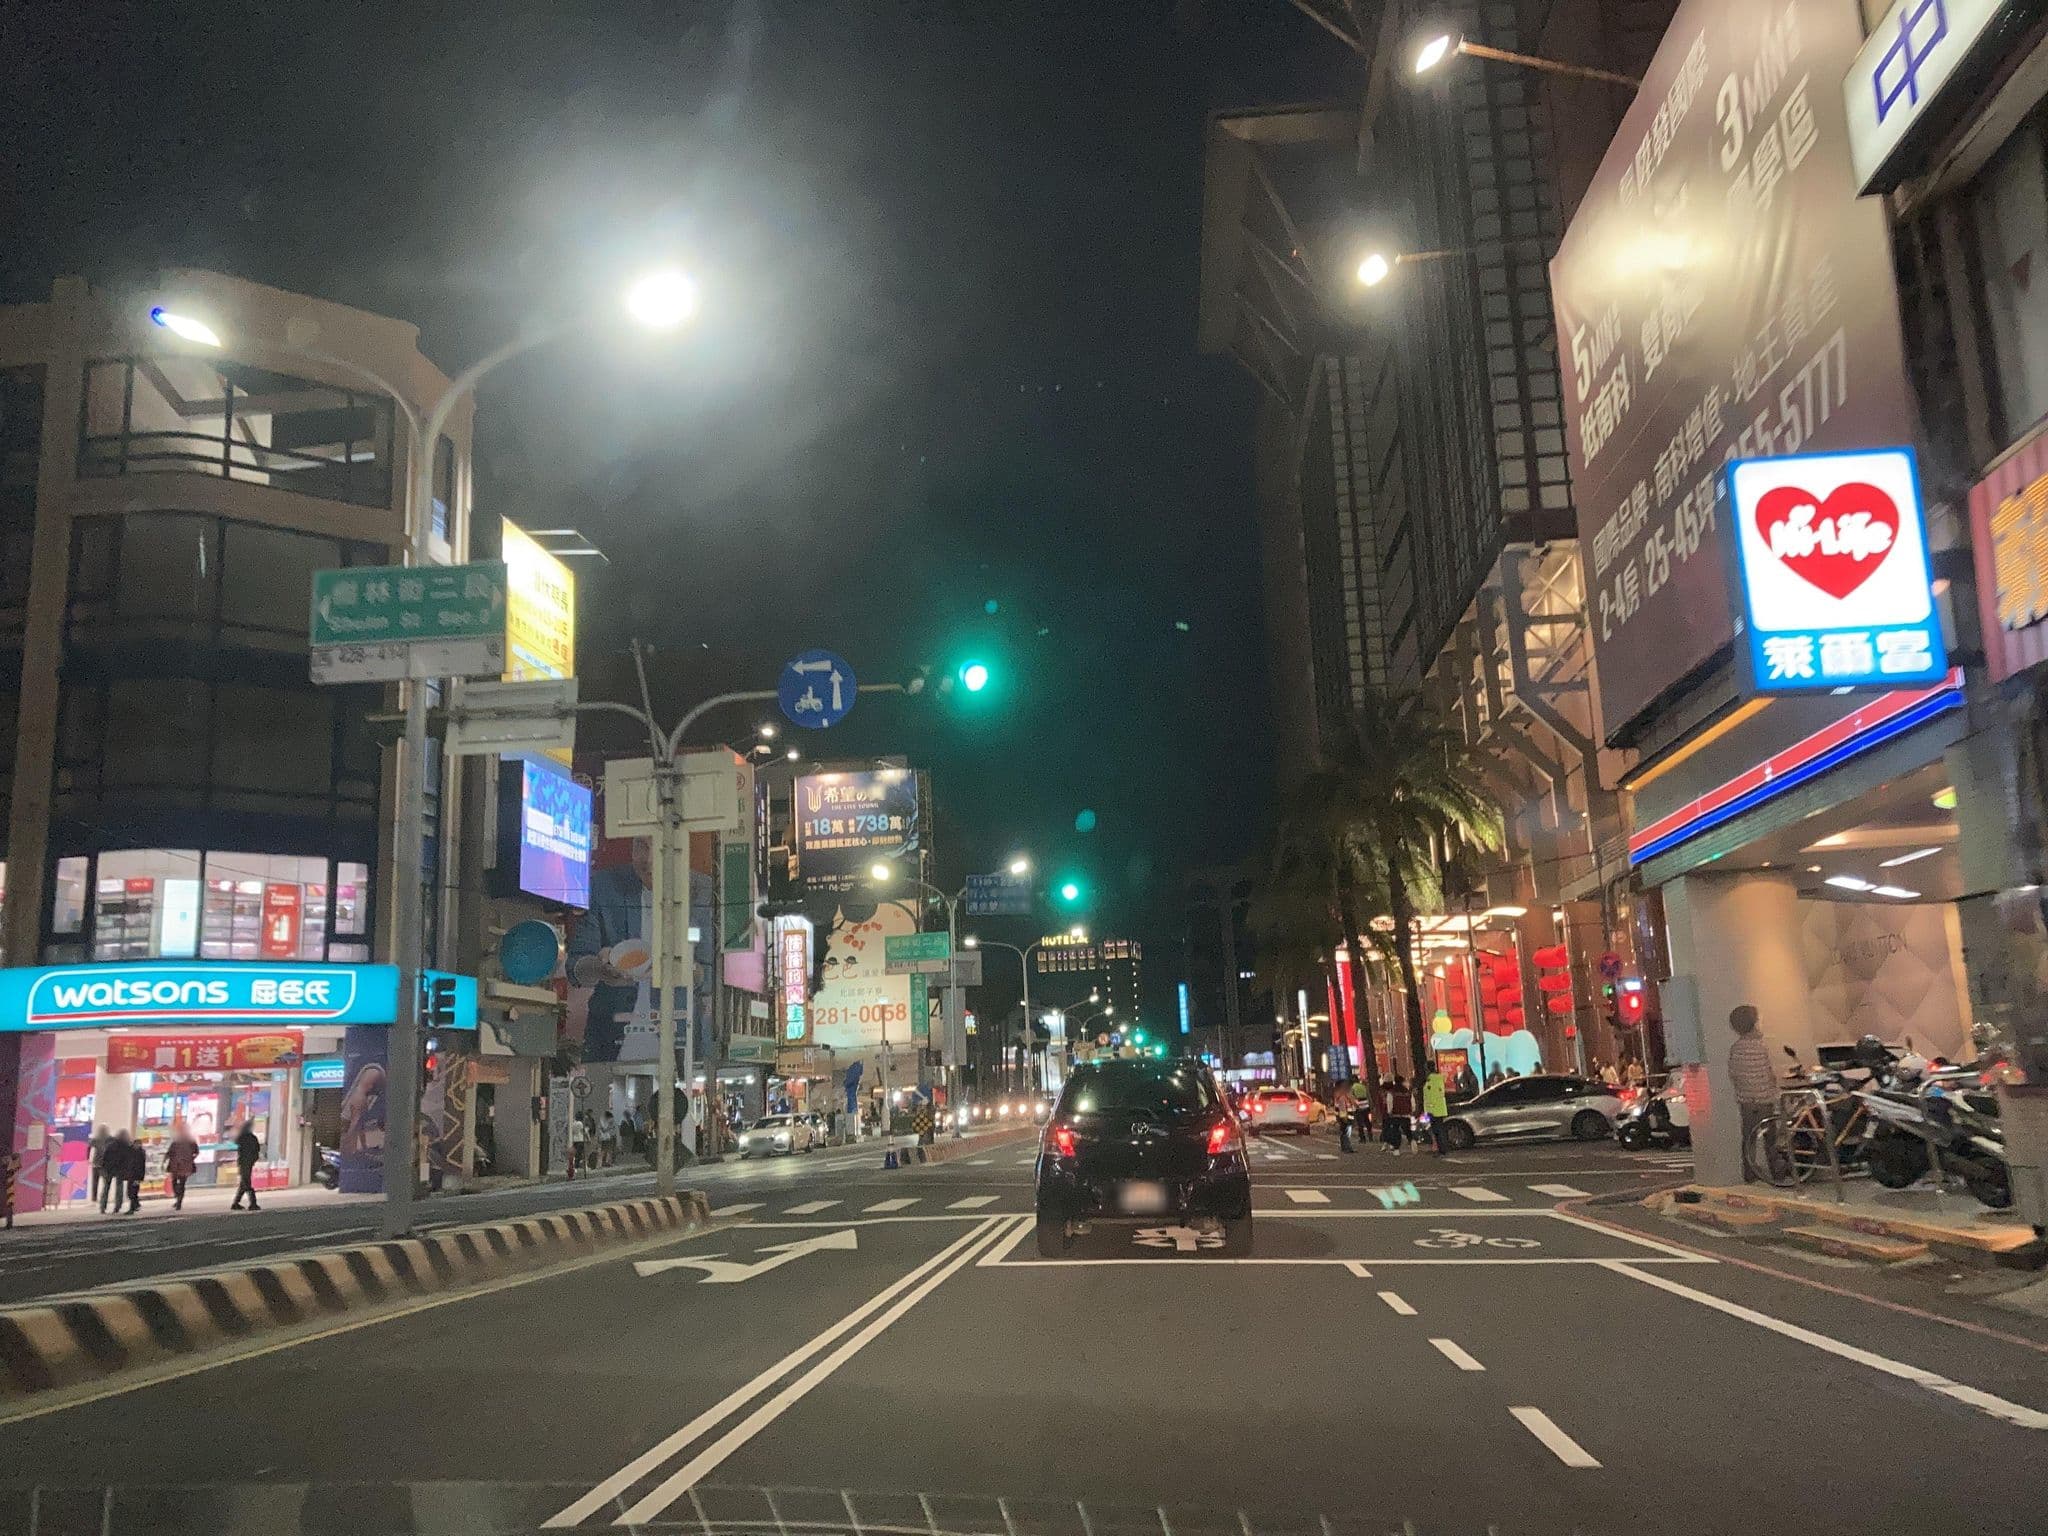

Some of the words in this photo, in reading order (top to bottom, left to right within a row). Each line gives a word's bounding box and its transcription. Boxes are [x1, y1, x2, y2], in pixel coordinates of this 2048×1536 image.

[53, 979, 230, 1008] watsons
[251, 979, 331, 1005] 屈臣氏
[815, 1003, 907, 1025] 281-0058
